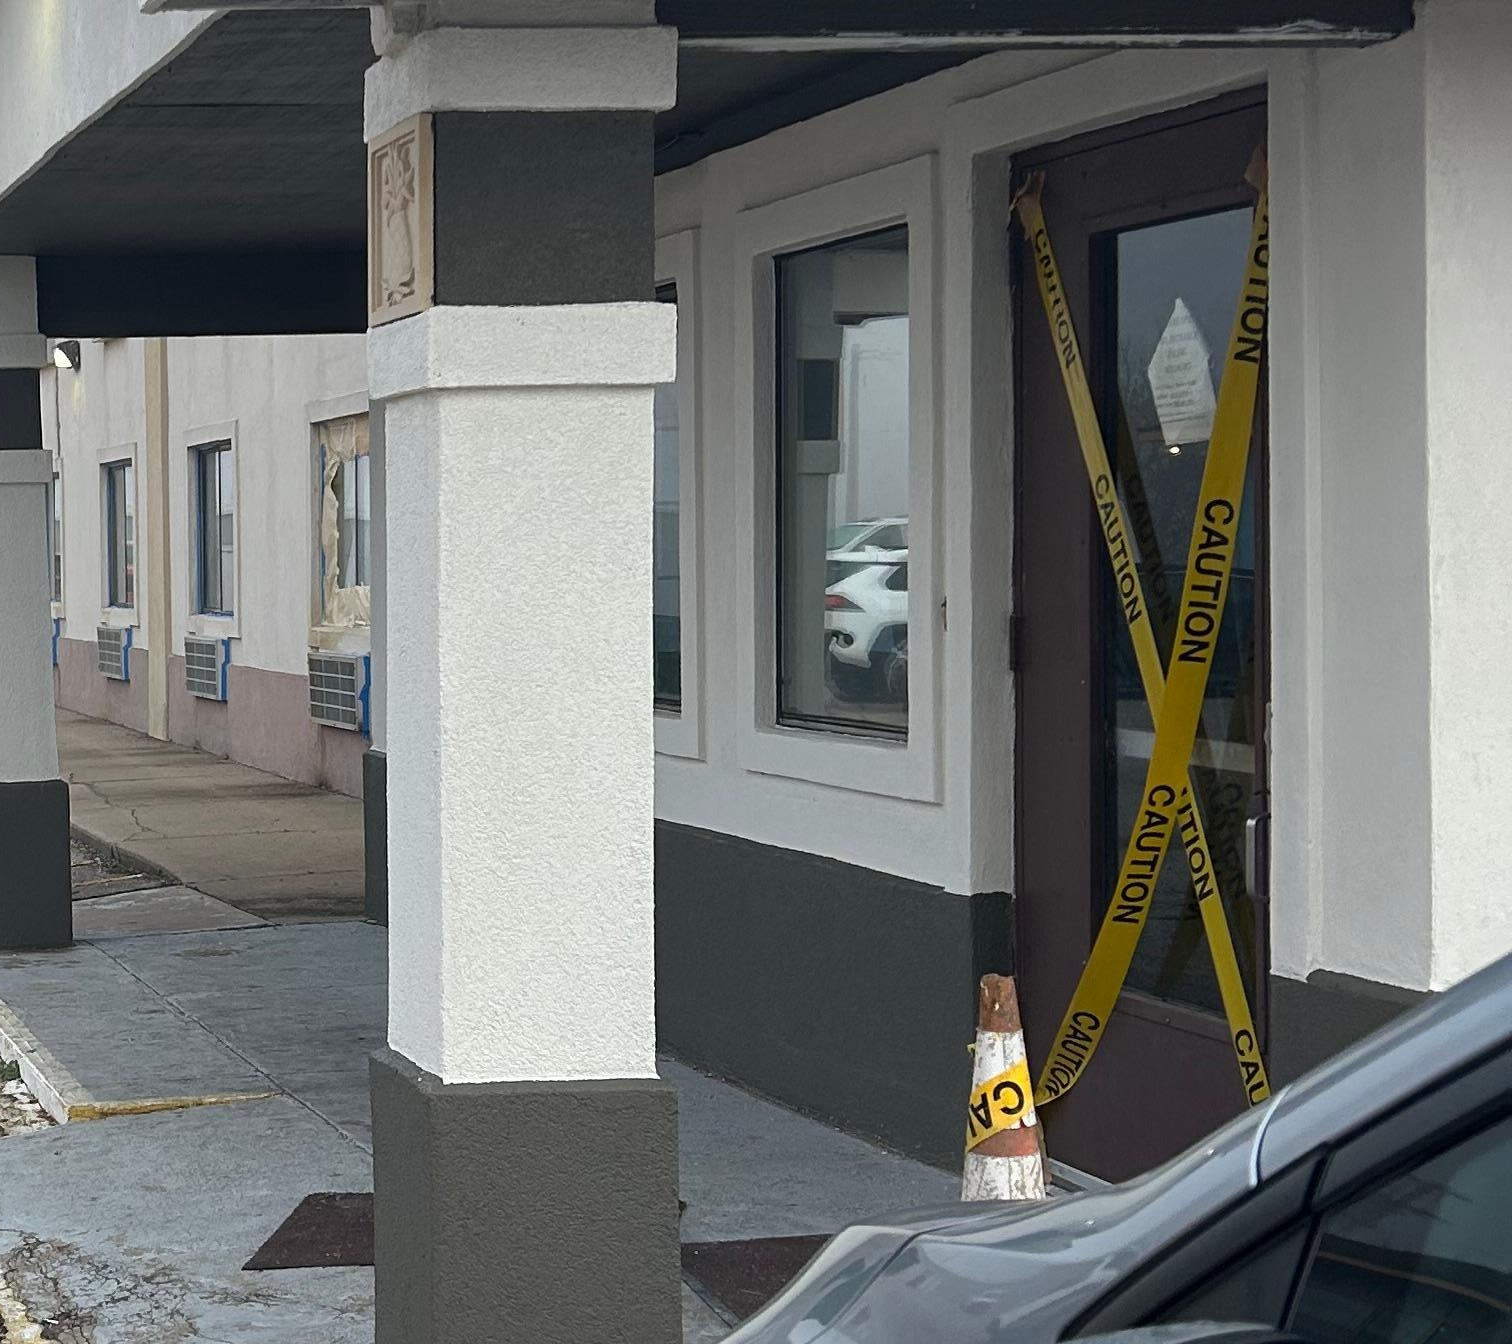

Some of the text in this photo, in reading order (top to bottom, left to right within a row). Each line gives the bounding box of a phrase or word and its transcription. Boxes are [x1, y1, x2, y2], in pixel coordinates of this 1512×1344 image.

[1094, 472, 1144, 625] CAUTION
[1177, 498, 1235, 665] CAUTION
[1111, 783, 1178, 925] CAUTION
